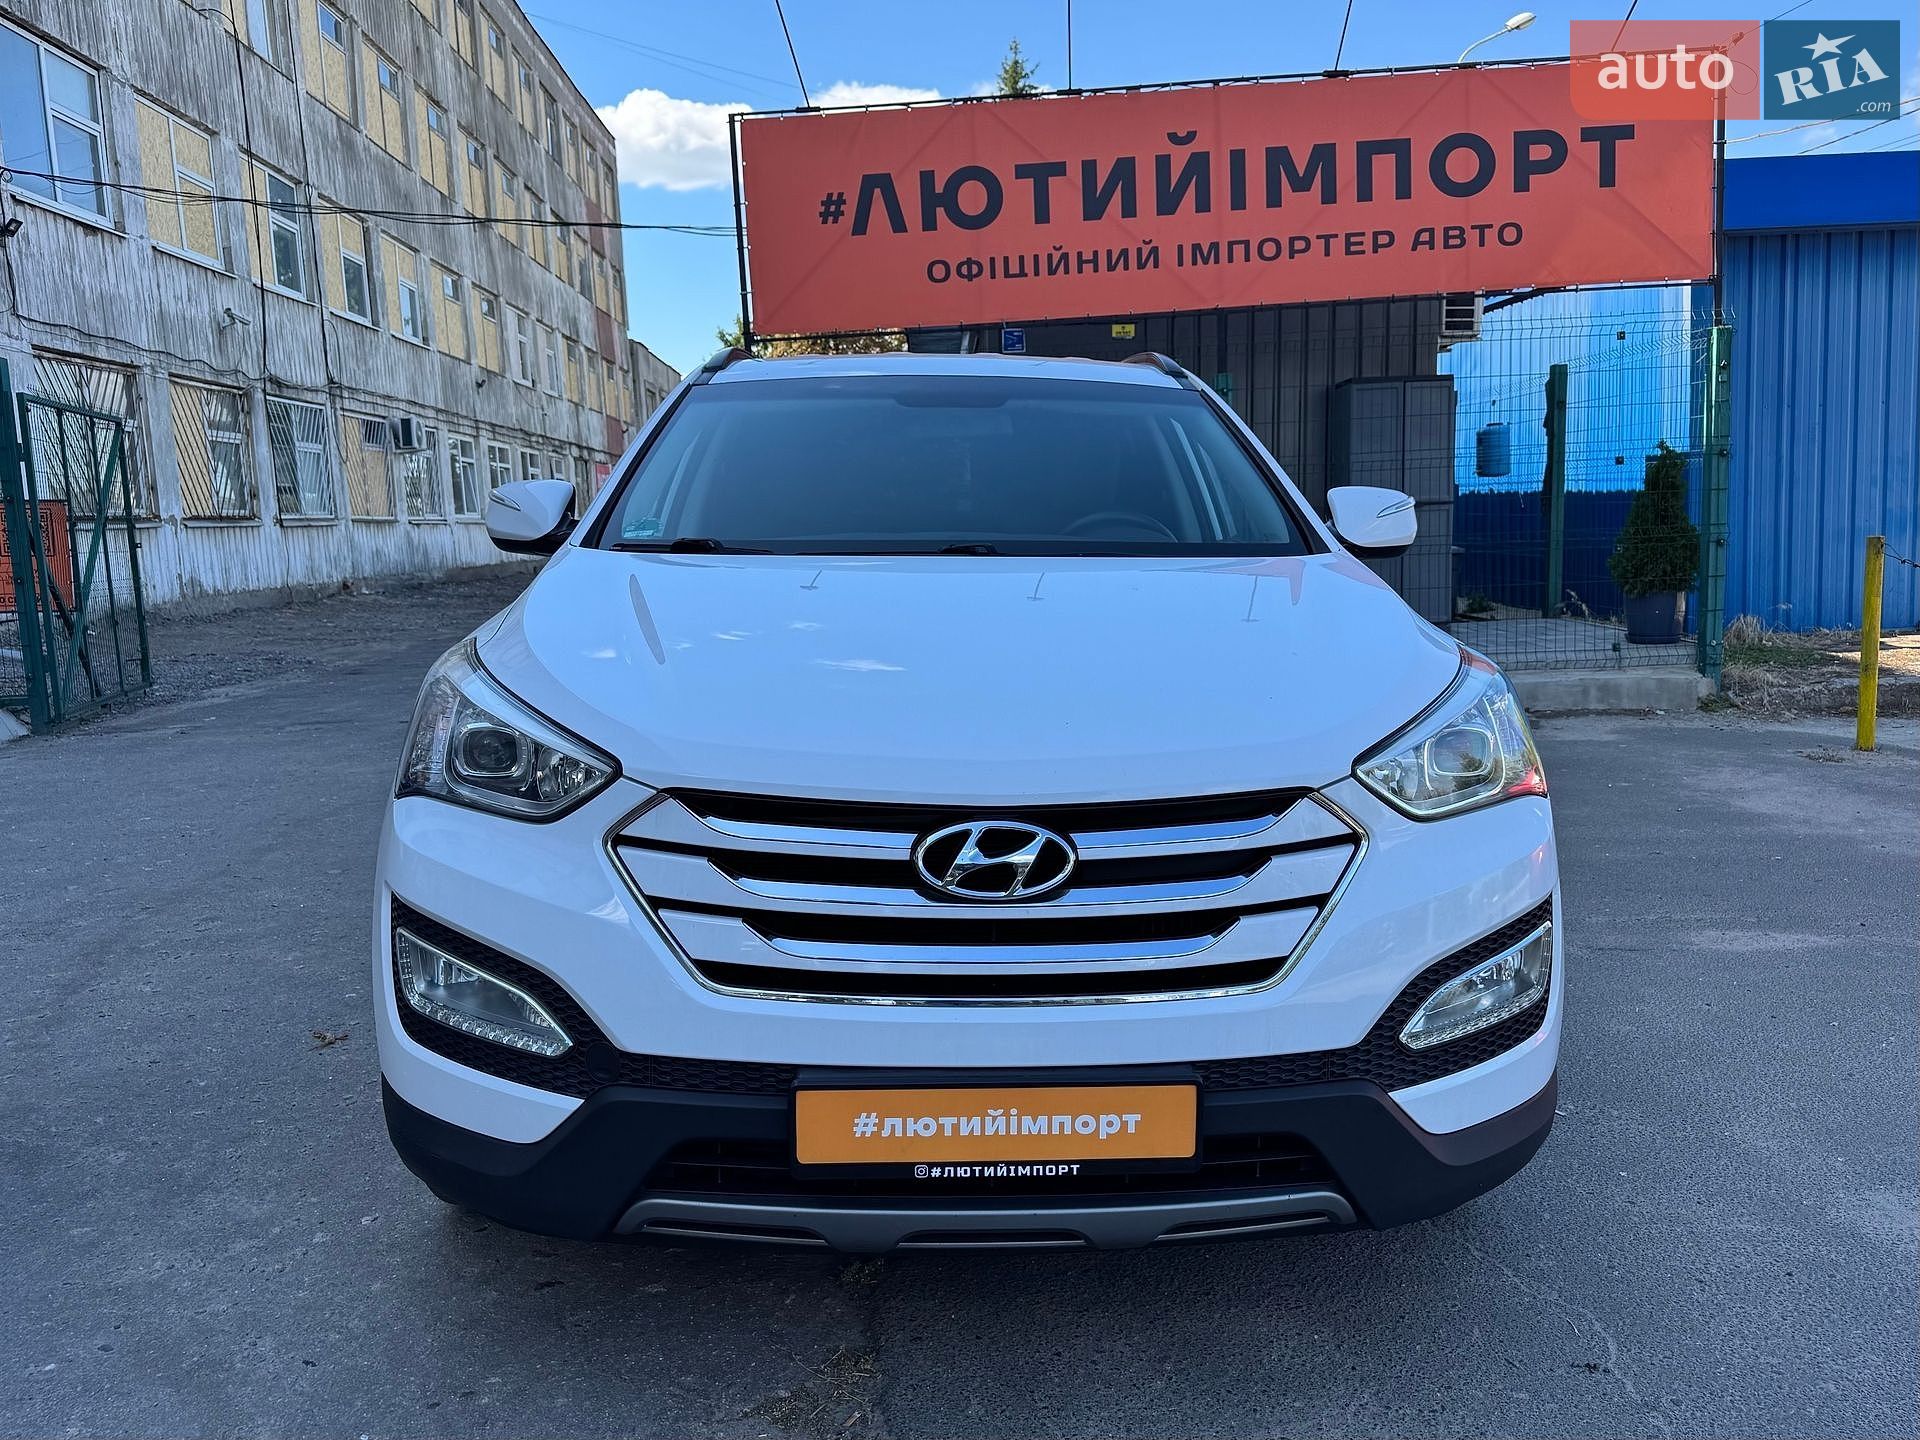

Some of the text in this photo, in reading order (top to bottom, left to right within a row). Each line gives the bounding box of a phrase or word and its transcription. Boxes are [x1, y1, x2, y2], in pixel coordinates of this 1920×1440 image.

[818, 123, 1636, 237] #ЛЮТИЙІМПОРТ
[926, 221, 1523, 284] ОФІЦІЙНИЙ ІМПОРТЕР АВТО
[852, 1107, 1142, 1140] #лютийімпорт
[930, 1163, 1081, 1179] #ЛЮТИЙІМПОРТ
